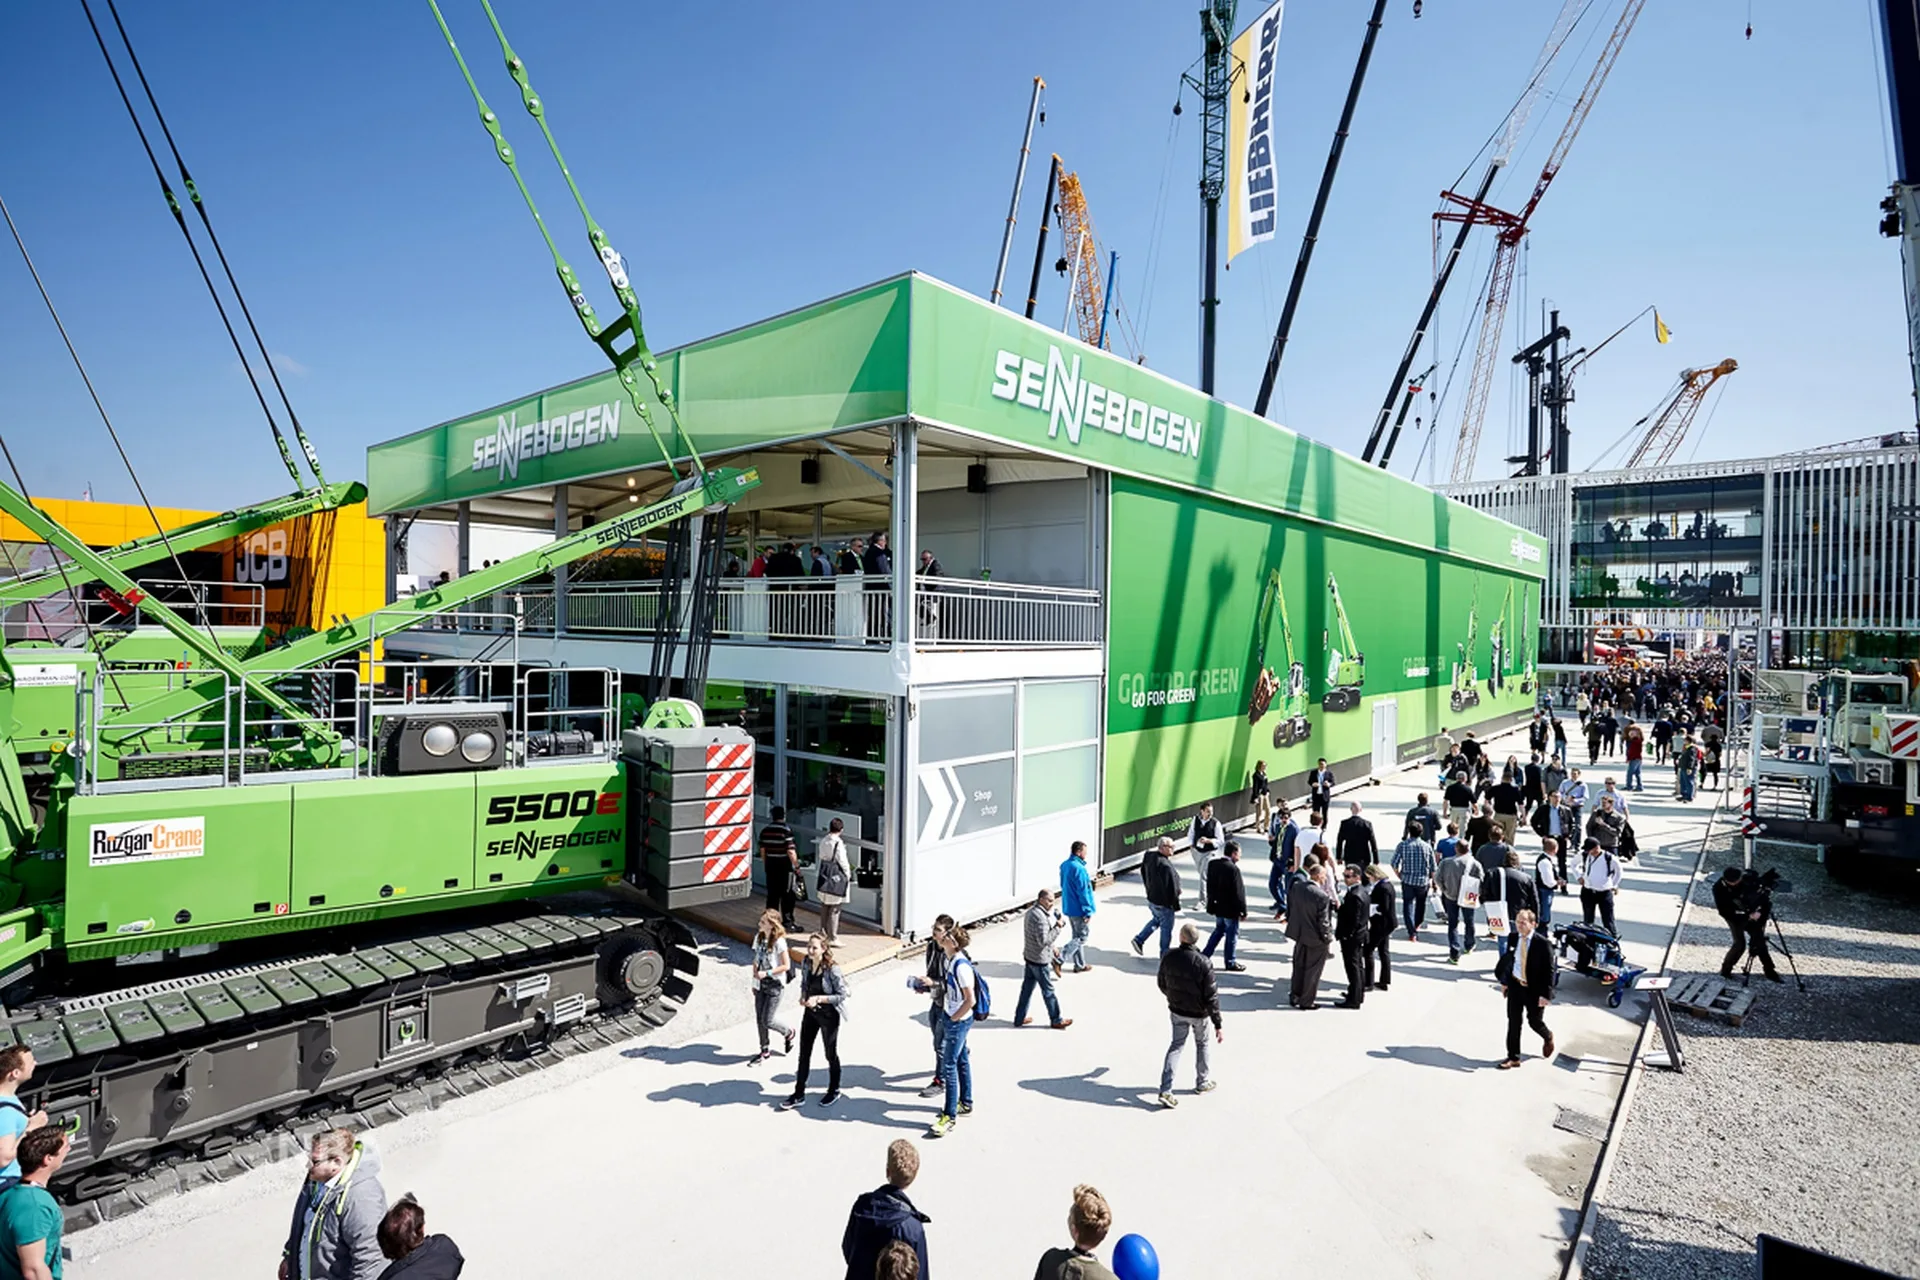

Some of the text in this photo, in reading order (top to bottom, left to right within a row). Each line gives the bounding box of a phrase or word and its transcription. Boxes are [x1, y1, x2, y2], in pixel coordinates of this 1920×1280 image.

[1248, 7, 1282, 237] LIEBHERR
[991, 344, 1201, 459] SENNEBOGEN
[472, 400, 622, 481] SENNEBOGEN
[595, 498, 684, 545] SENNEBOGEN
[236, 529, 287, 583] JCB
[1118, 673, 1145, 704] GO
[1189, 667, 1239, 697] GREEN
[1132, 688, 1196, 708] GO FOR GREEN
[486, 789, 622, 826] 5500E
[486, 828, 622, 861] SENNEBOGEN
